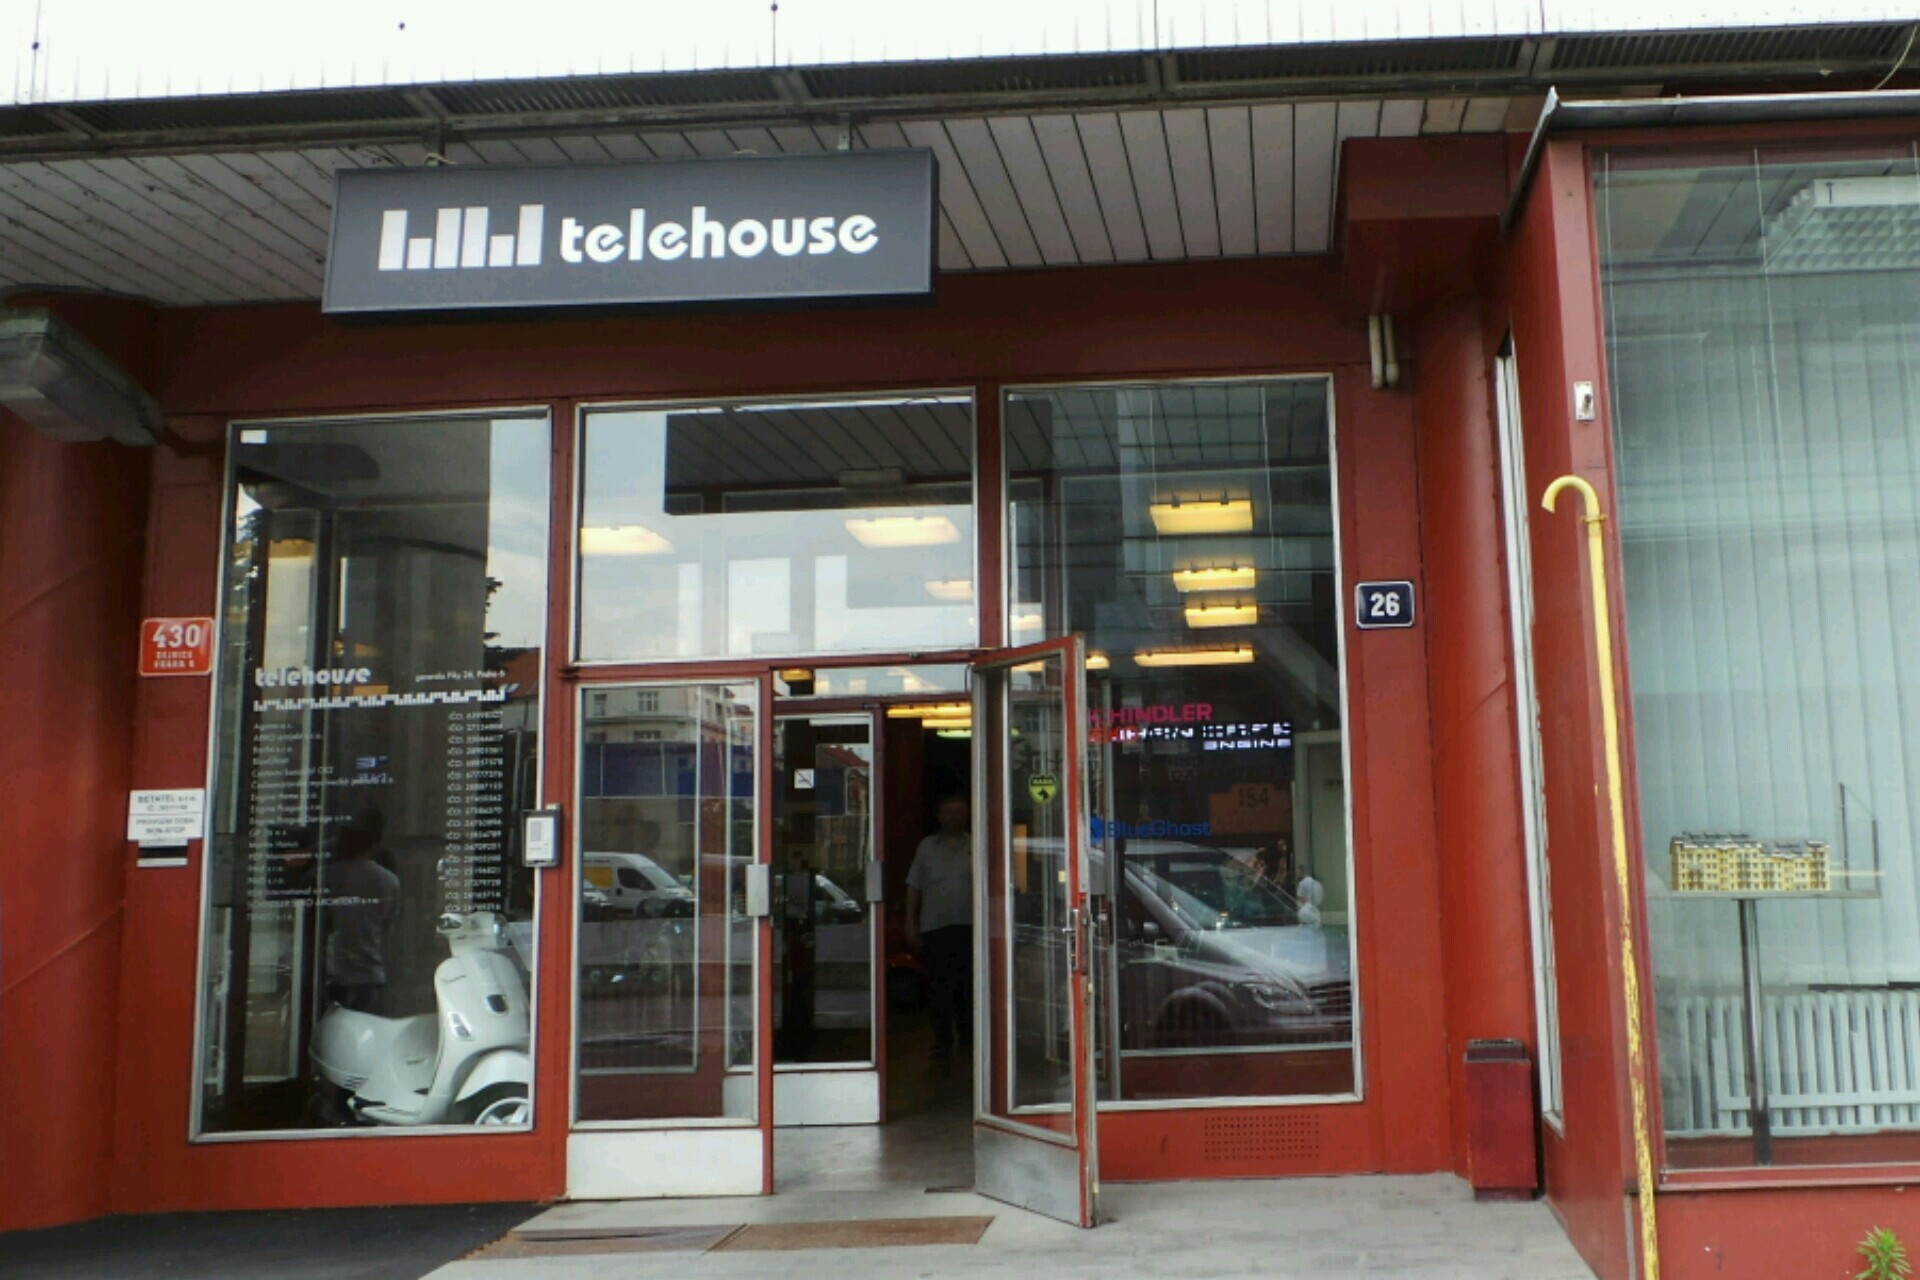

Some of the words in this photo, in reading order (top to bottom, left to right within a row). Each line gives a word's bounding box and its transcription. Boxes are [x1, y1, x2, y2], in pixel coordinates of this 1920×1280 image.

[560, 206, 879, 263] telehouse
[1371, 592, 1400, 616] 26
[153, 624, 201, 648] 430
[255, 667, 371, 687] telehouse
